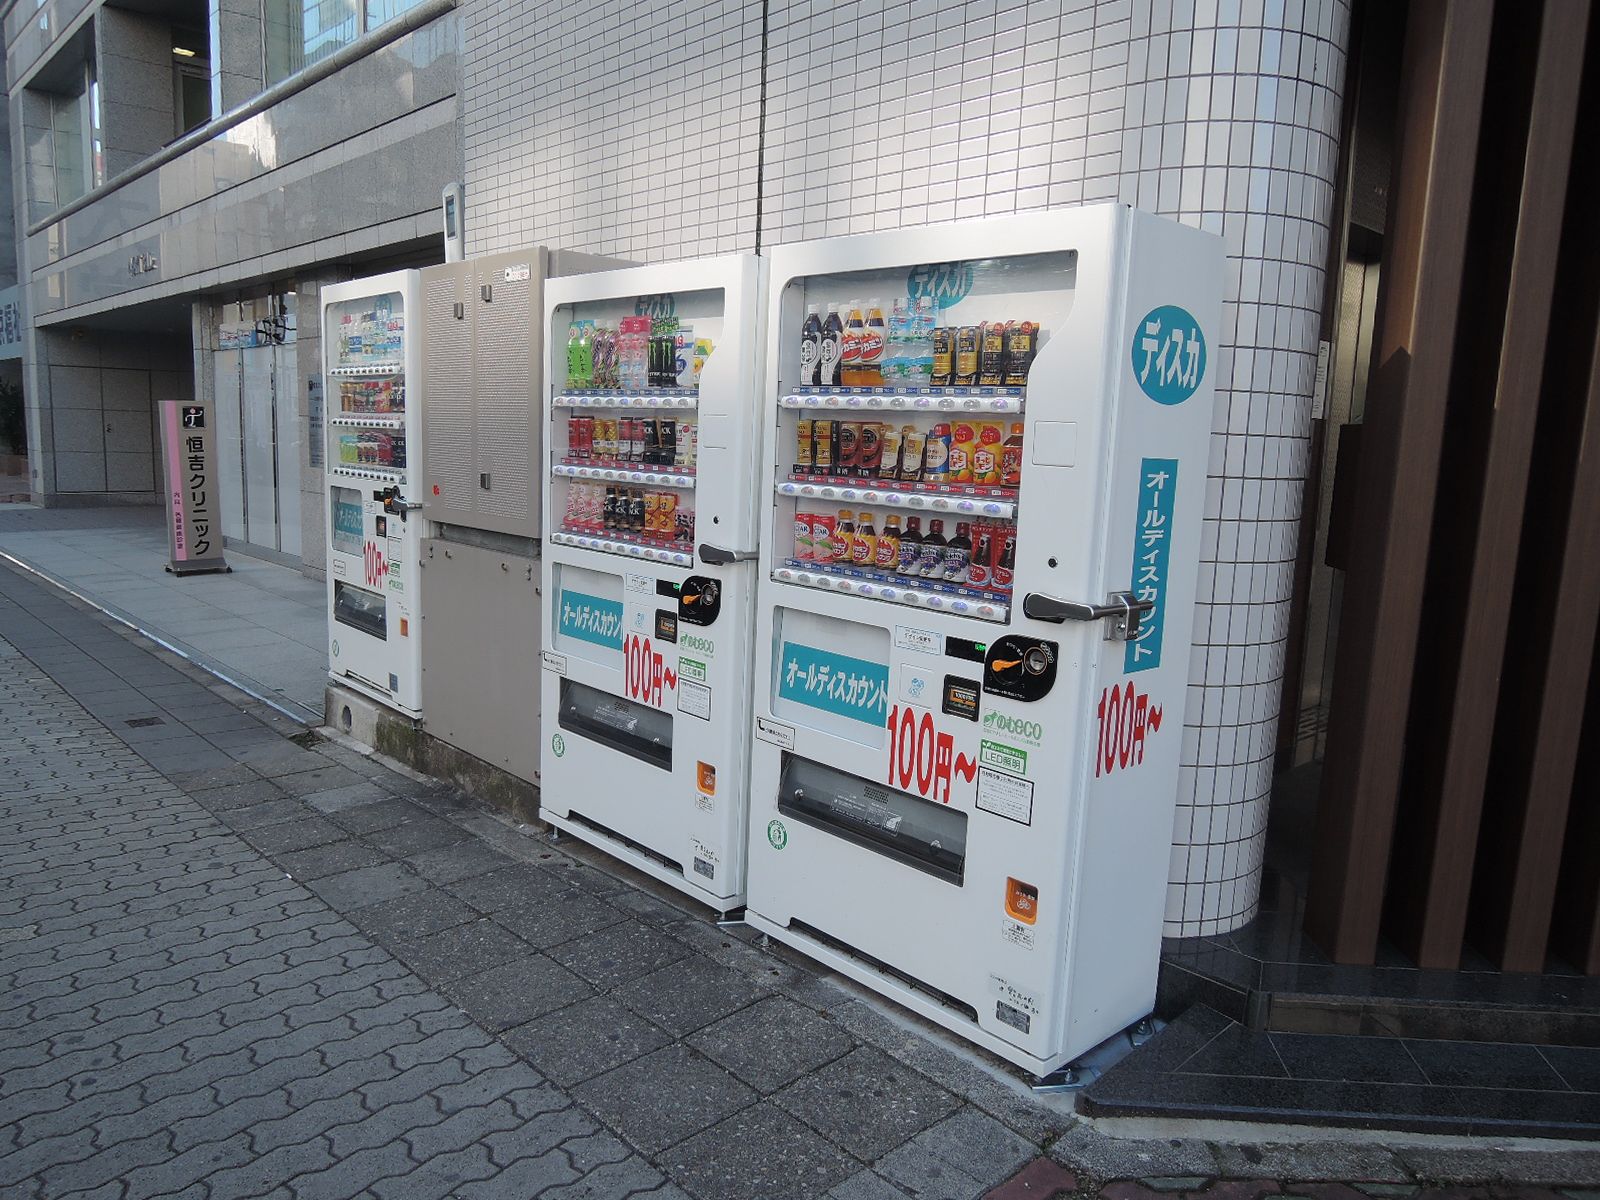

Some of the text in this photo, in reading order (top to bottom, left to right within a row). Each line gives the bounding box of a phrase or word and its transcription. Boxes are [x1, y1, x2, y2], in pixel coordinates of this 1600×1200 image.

[1140, 316, 1200, 389] ディスカ
[185, 436, 210, 556] 恒吉クリニック
[786, 656, 888, 714] オールディスカウント
[985, 750, 1022, 770] LED照明
